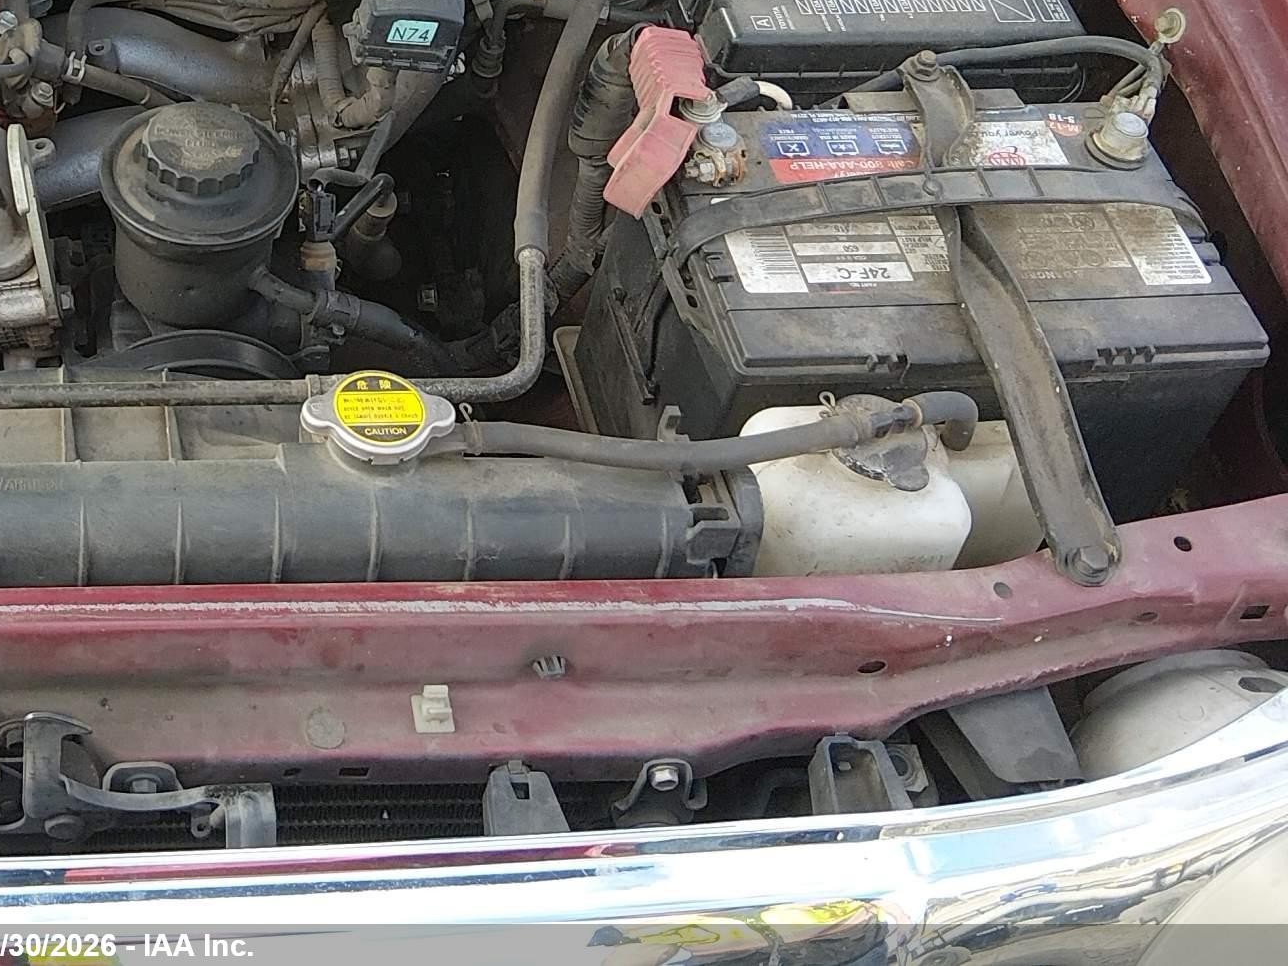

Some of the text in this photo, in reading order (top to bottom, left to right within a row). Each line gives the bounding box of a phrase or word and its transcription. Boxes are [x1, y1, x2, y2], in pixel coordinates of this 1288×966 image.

[770, 6, 789, 29] TOYOTA
[755, 19, 772, 27] A
[392, 27, 430, 41] N74
[1008, 129, 1039, 138] Power
[790, 160, 883, 170] 800-AAA-HELP
[837, 266, 891, 280] 24F-C
[365, 427, 408, 435] CAUTION
